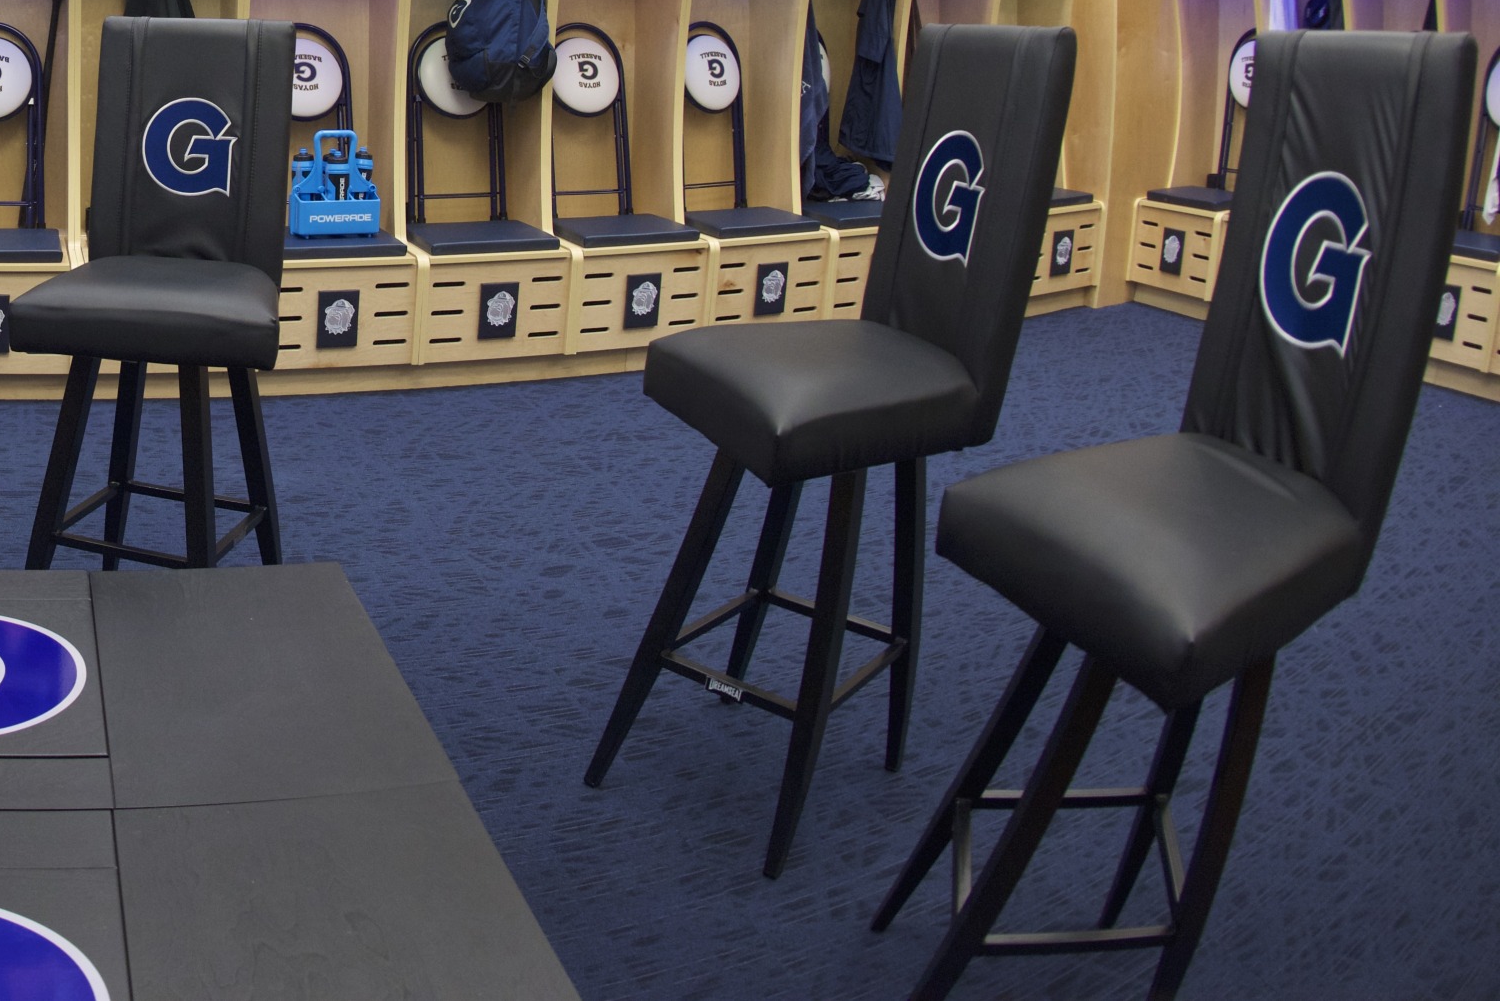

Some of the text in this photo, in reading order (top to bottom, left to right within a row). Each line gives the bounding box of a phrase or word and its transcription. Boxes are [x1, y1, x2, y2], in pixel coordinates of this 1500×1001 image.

[569, 53, 602, 61] BASEBALL
[142, 97, 238, 197] G
[310, 214, 372, 223] POWERADE
[913, 129, 985, 268] G
[1259, 170, 1373, 358] G
